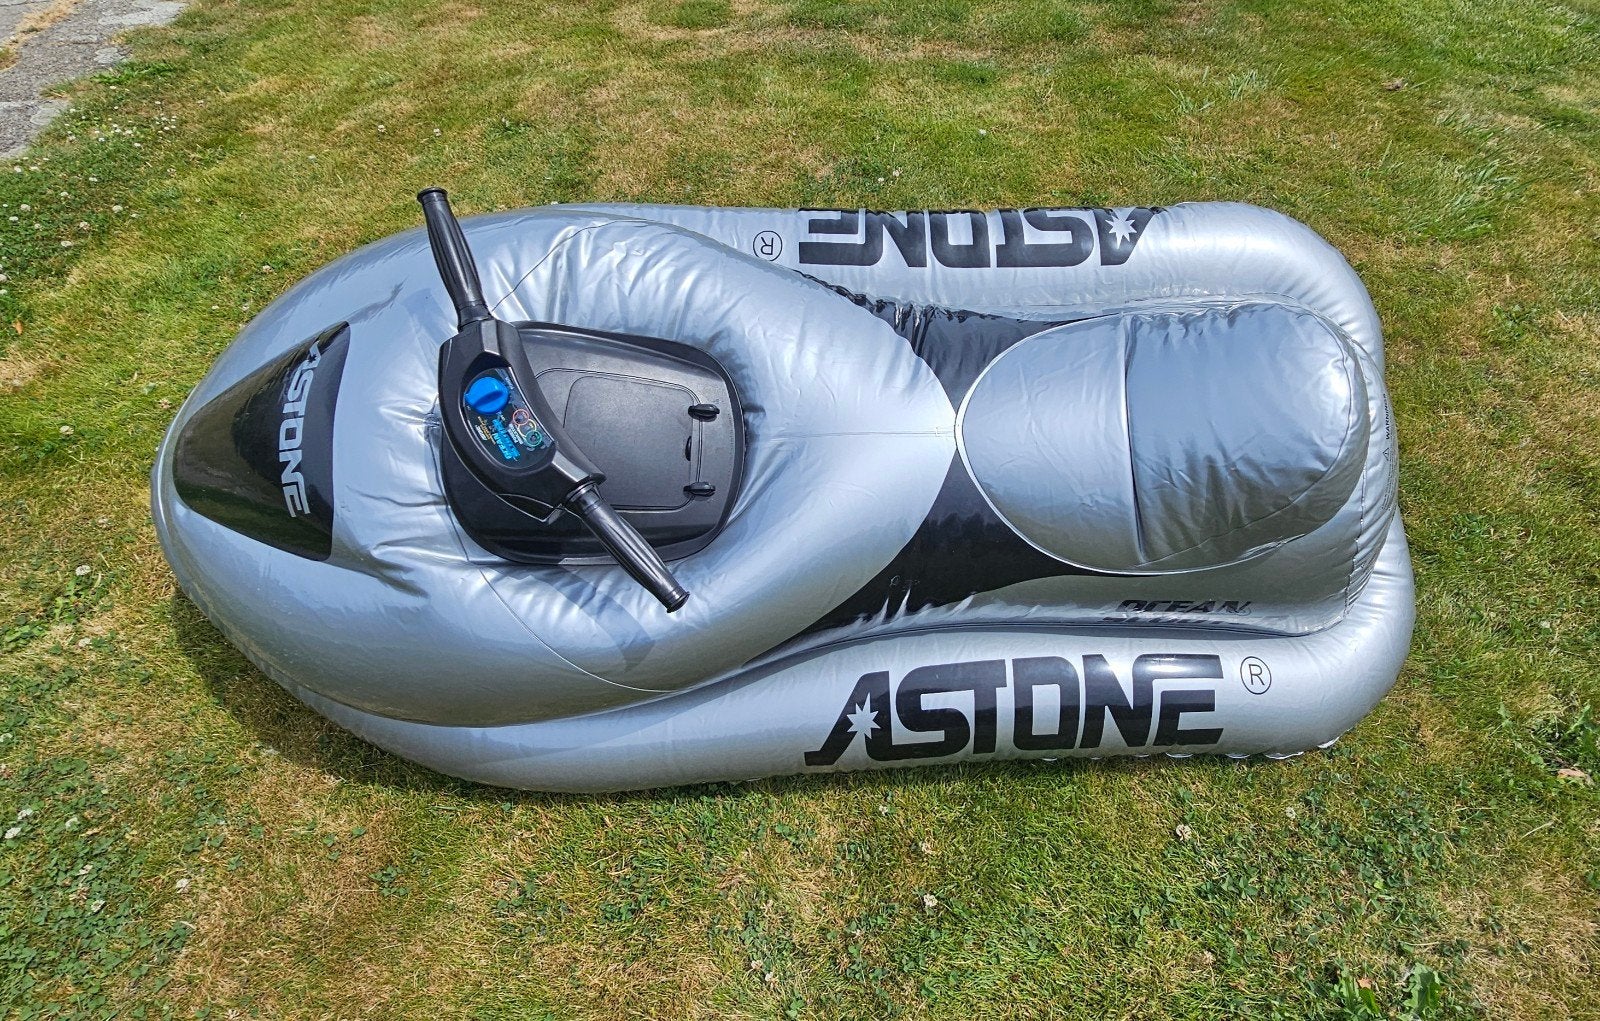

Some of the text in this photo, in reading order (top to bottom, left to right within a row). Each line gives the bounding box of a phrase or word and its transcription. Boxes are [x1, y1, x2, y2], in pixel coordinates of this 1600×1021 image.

[799, 207, 1157, 268] ASTONE
[278, 340, 321, 518] ASTONE
[804, 654, 1224, 766] ASTONE
